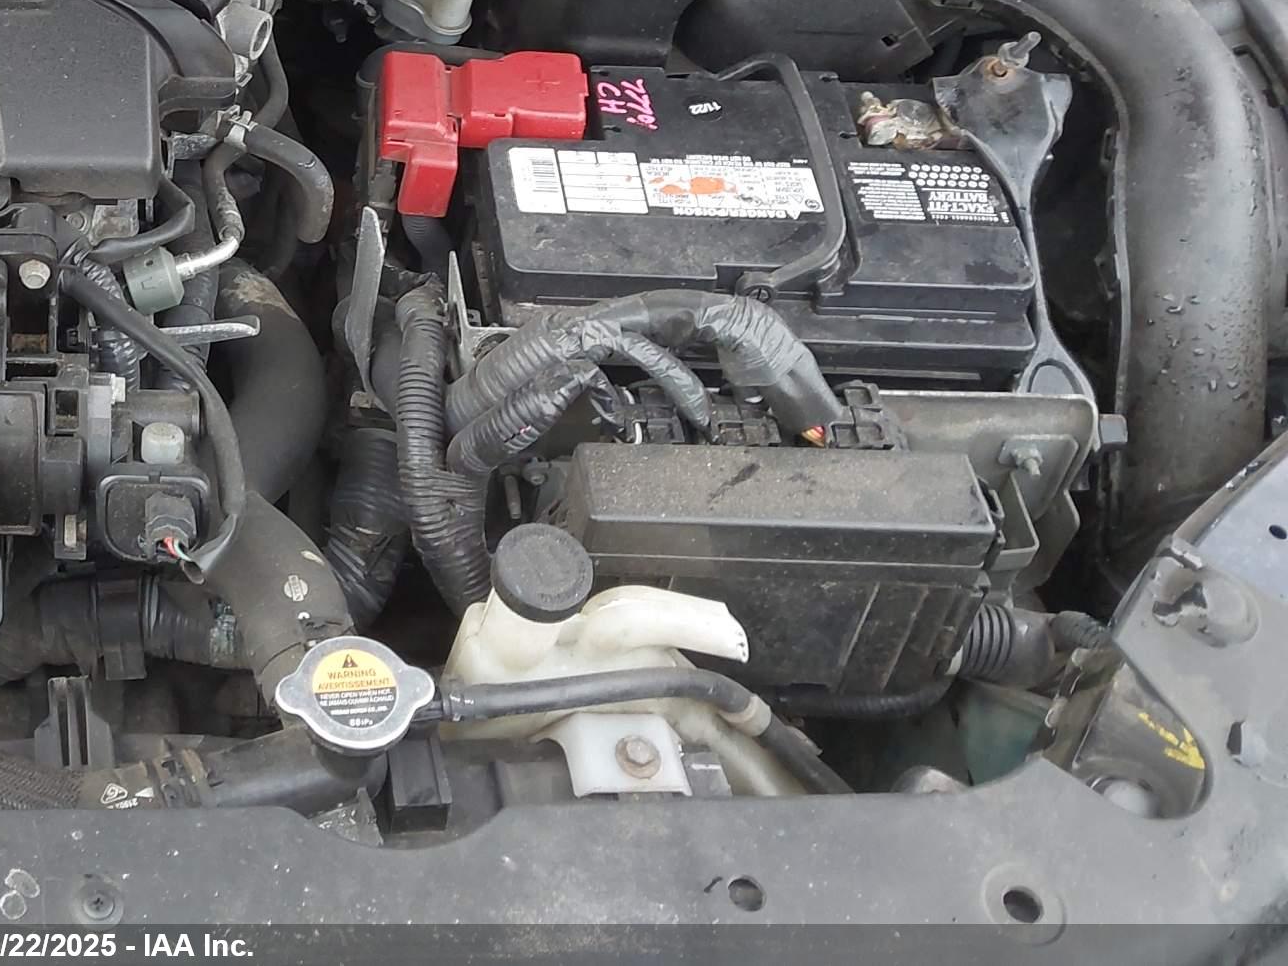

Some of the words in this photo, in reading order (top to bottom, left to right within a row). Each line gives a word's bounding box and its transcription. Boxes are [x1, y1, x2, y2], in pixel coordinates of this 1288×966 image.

[597, 82, 627, 114] CH
[928, 191, 988, 203] BATTERY
[673, 206, 787, 219] DANGER/POISON
[927, 201, 995, 214] EXACT-FIT
[327, 669, 376, 680] WARNING
[318, 677, 390, 690] AVERTISSEMENT
